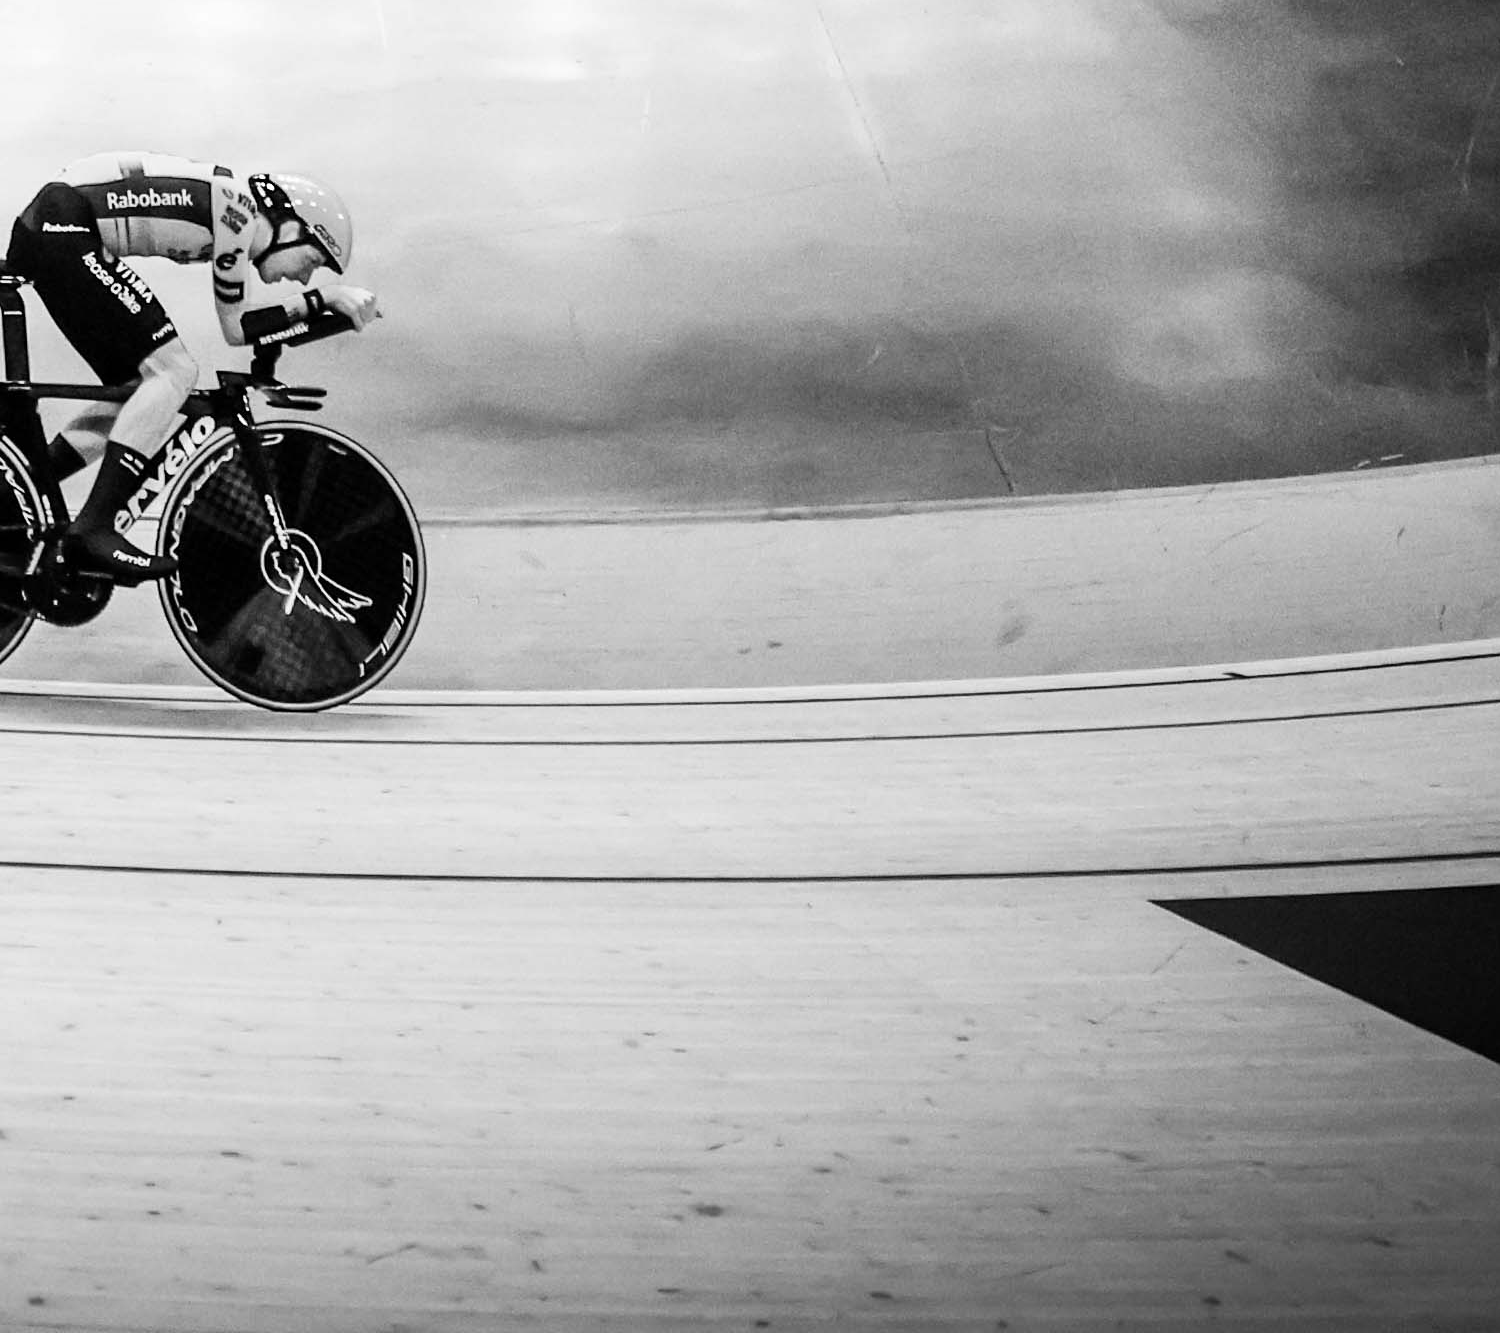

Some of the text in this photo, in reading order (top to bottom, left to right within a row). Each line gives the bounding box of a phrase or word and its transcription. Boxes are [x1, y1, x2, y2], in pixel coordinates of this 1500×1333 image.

[106, 187, 194, 211] Rabobank
[114, 256, 155, 304] VISMA
[113, 414, 216, 535] ervélo
[112, 549, 152, 568] nimbl
[358, 551, 415, 678] GHIBLI
